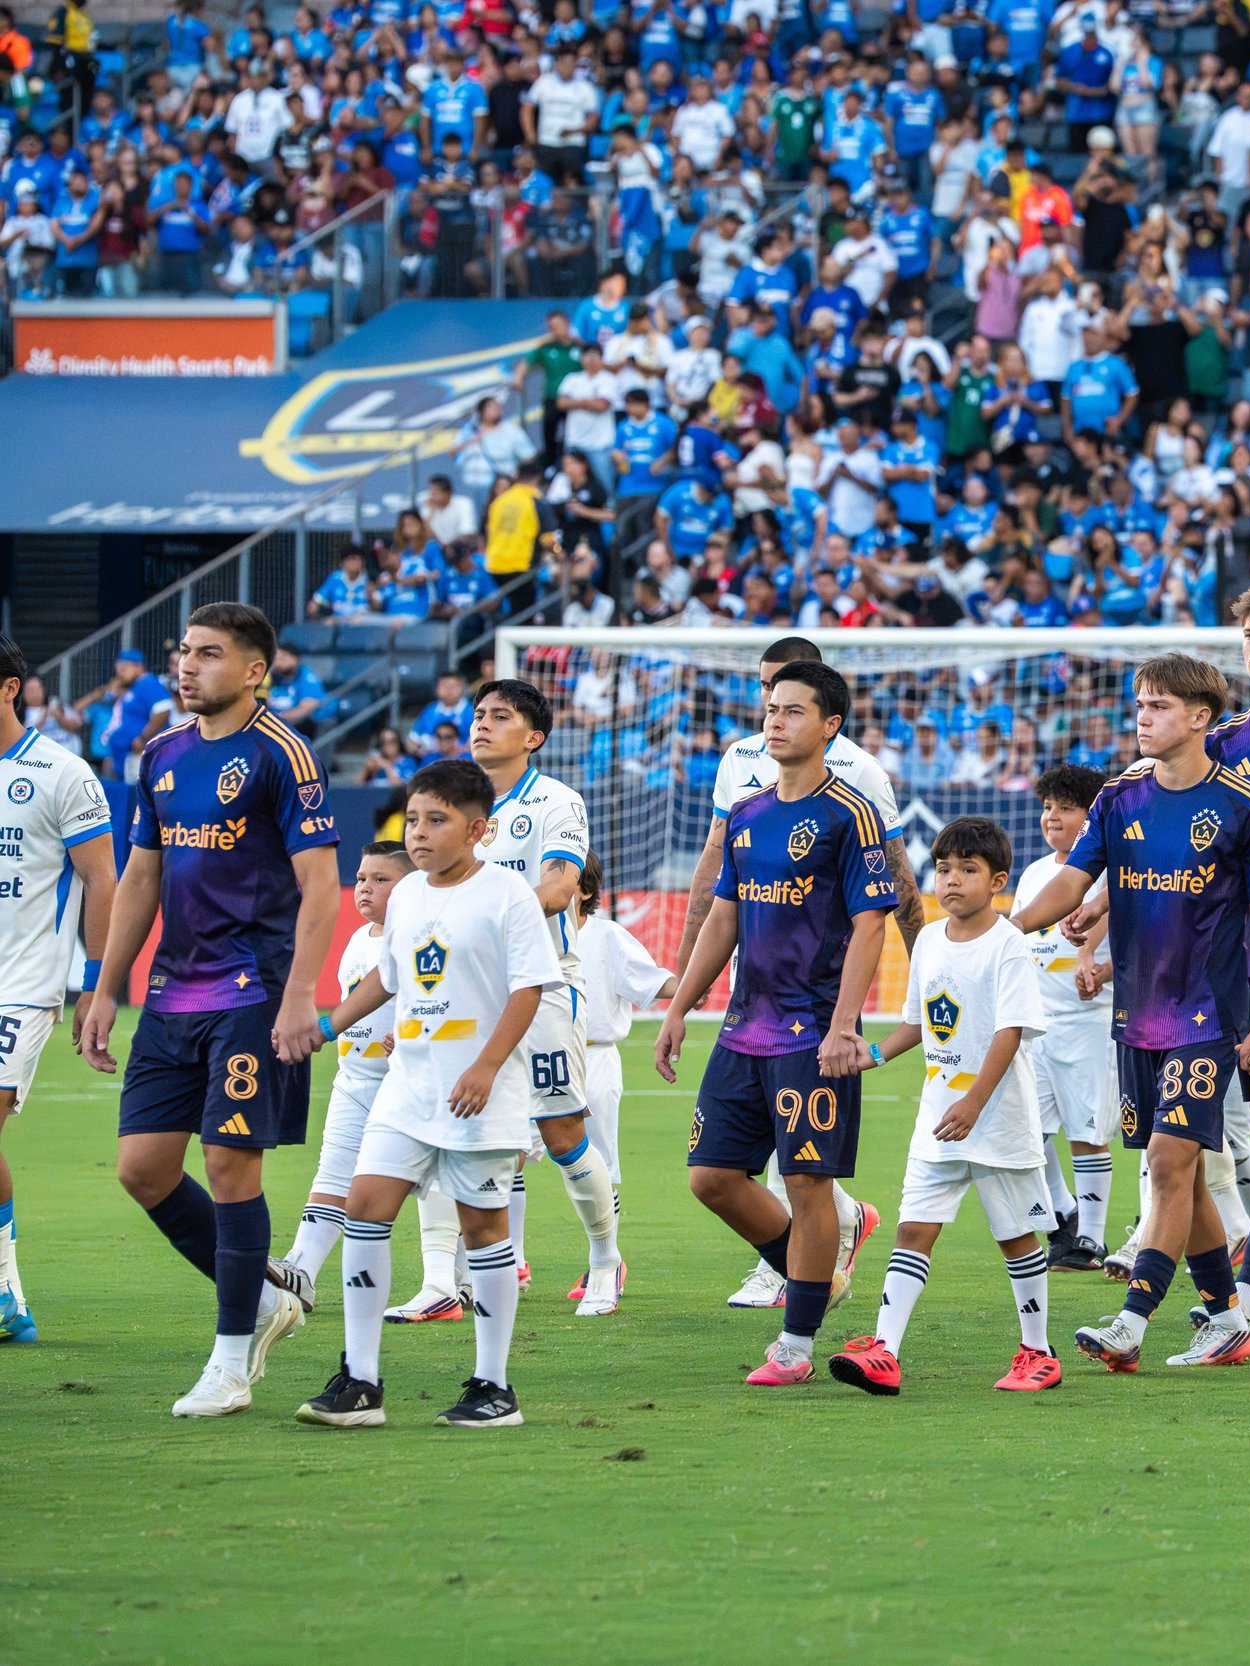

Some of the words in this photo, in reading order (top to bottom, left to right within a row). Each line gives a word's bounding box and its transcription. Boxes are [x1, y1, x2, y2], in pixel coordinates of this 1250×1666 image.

[234, 355, 268, 376] Park
[16, 759, 53, 769] novibet
[222, 779, 237, 791] LA
[519, 795, 548, 806] noibt
[160, 821, 235, 850] erbalife
[1196, 828, 1211, 839] LA
[793, 838, 807, 849] LA
[879, 881, 895, 894] tv
[1119, 866, 1205, 894] Herbalife
[738, 879, 804, 906] erbalife
[420, 957, 441, 972] LA
[933, 1008, 952, 1025] LA
[0, 1015, 21, 1054] 5
[224, 1053, 259, 1100] 8
[532, 1050, 570, 1089] 60
[1163, 1057, 1217, 1100] 88
[776, 1087, 837, 1133] 90
[1123, 1114, 1134, 1124] LA
